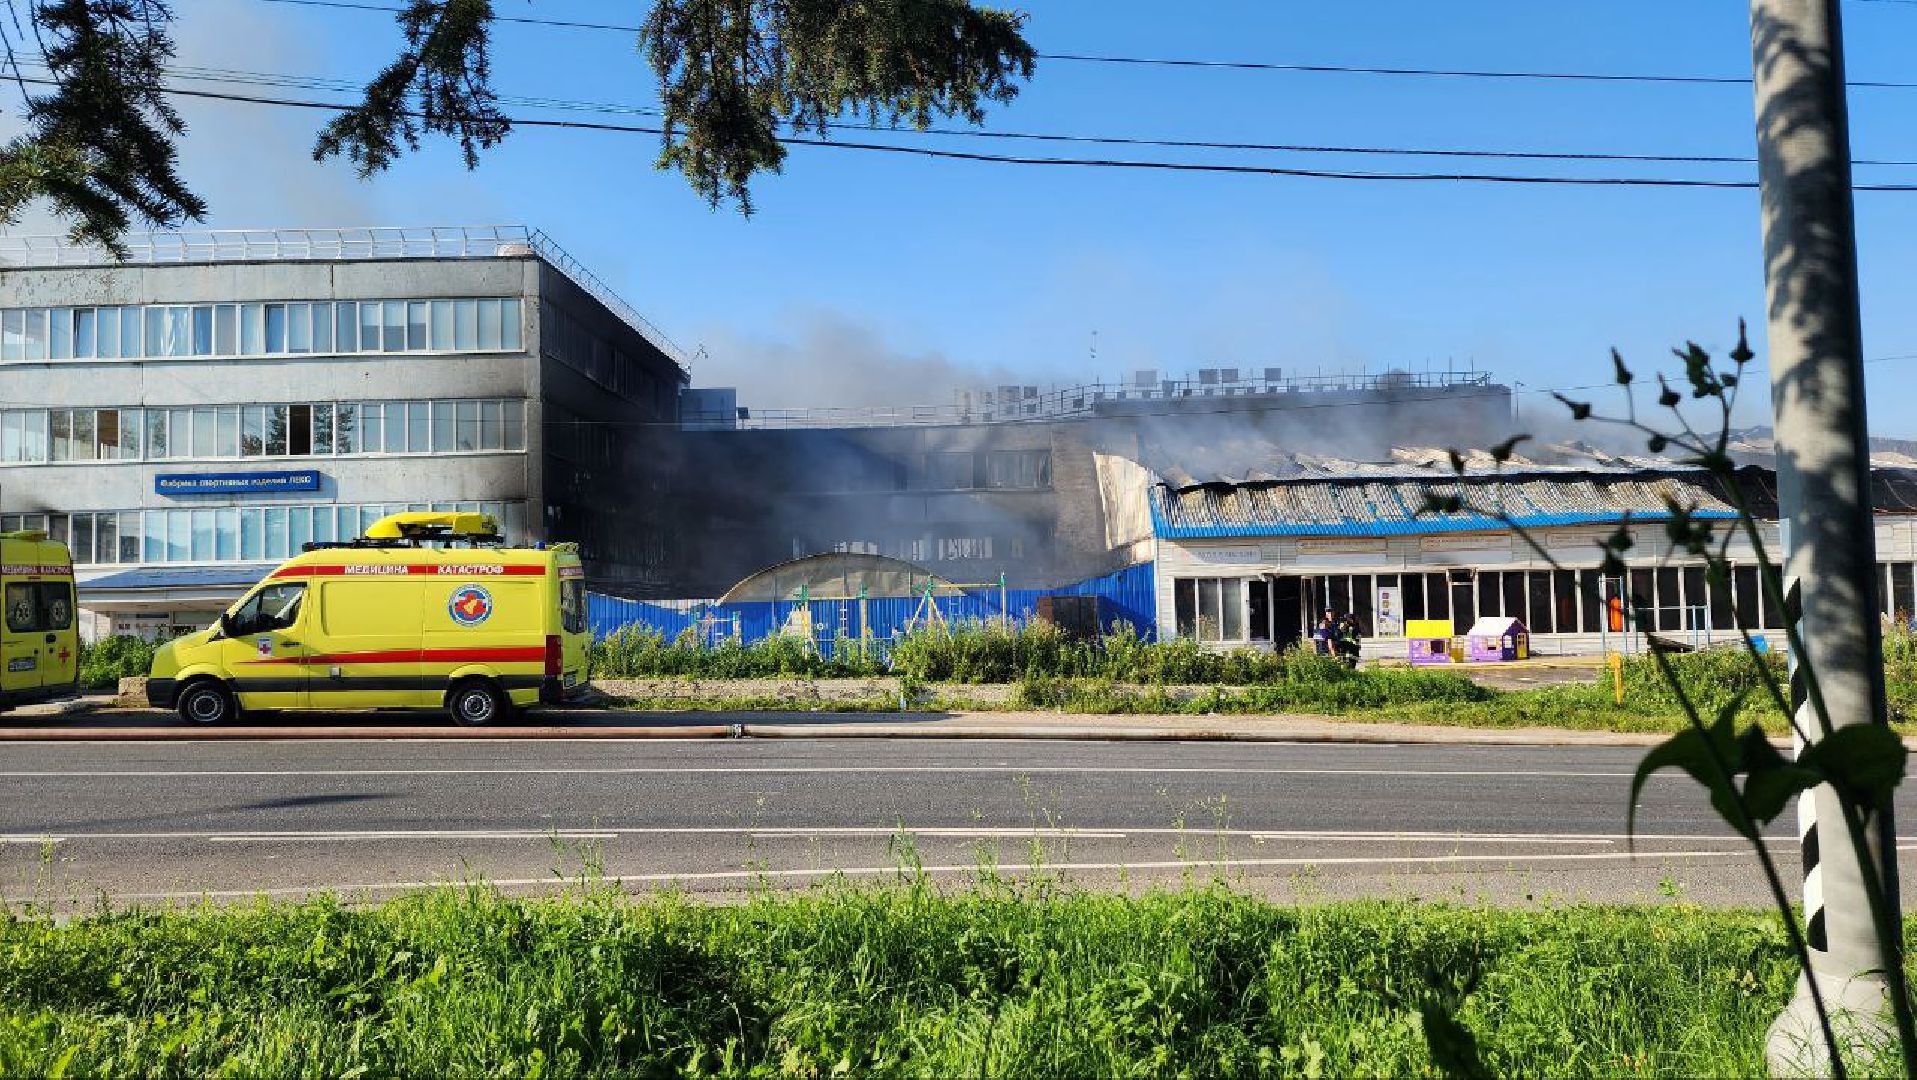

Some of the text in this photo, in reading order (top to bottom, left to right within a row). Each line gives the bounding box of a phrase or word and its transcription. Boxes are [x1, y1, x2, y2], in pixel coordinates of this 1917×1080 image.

[160, 479, 197, 488] Фабрика
[344, 564, 504, 575] МЕДИЦИНА КАТАСТРОФ
